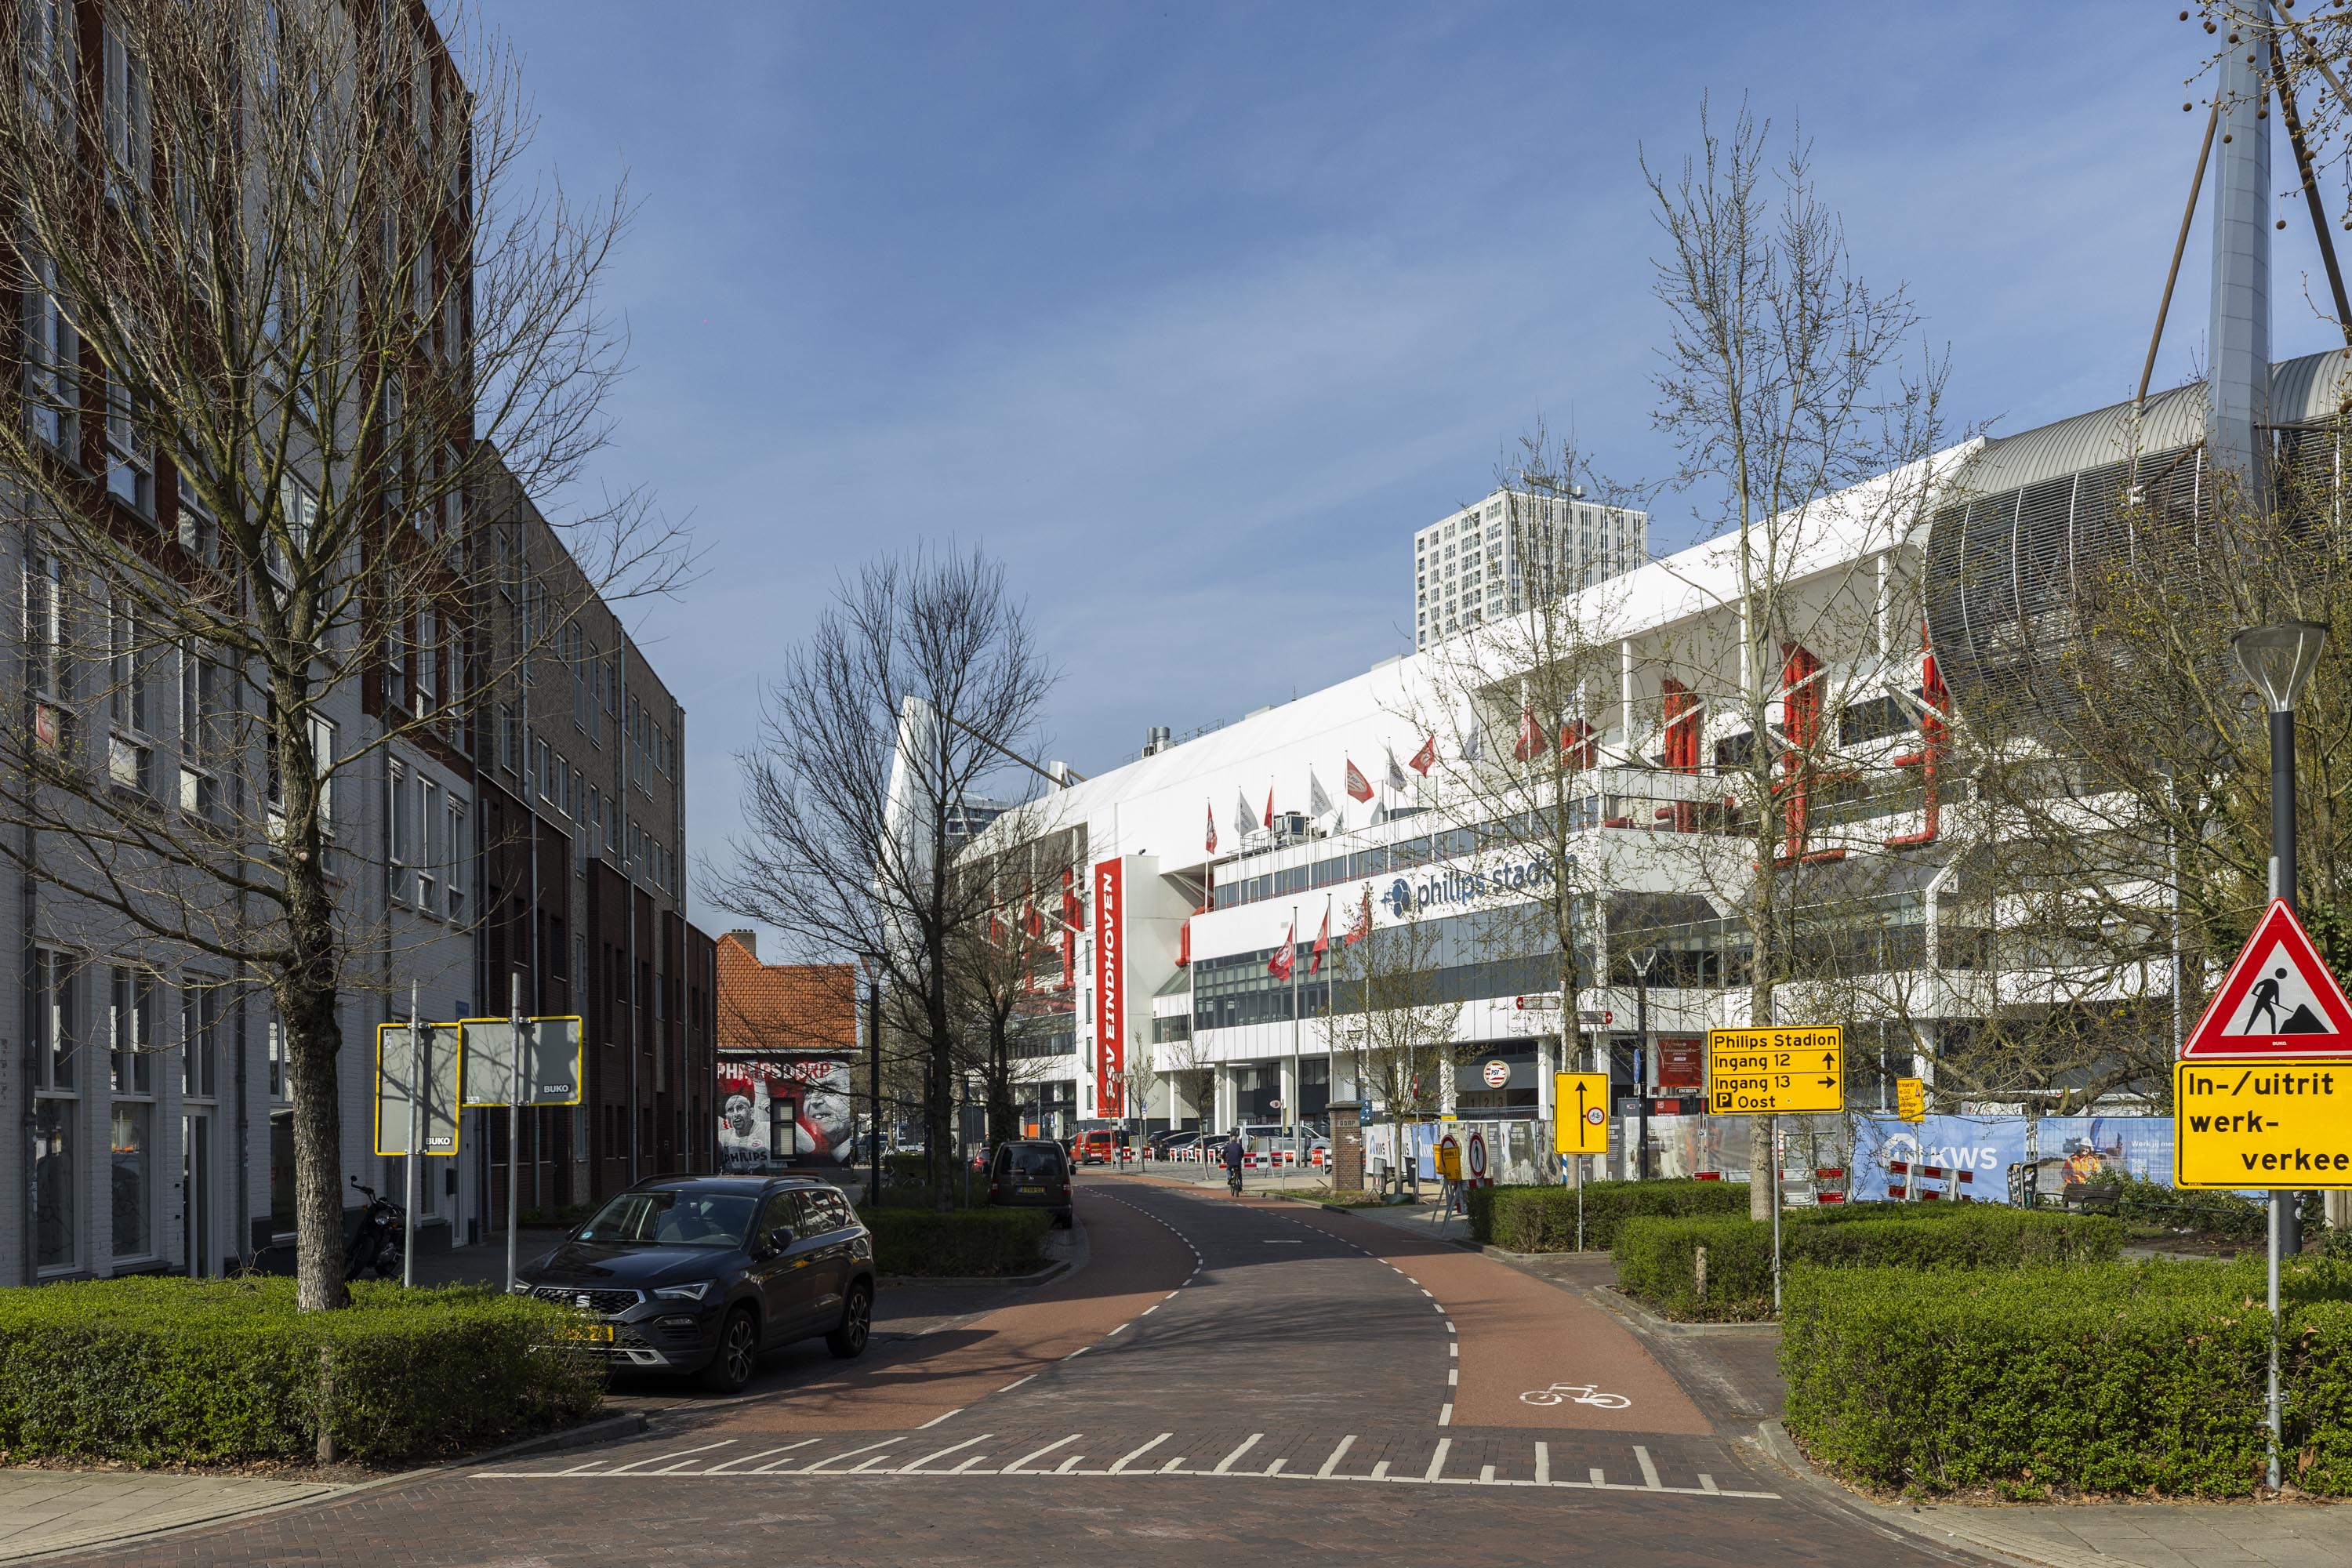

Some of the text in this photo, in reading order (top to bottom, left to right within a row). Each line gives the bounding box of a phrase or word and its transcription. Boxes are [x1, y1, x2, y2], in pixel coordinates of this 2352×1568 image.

[1417, 869, 1485, 912] philips
[1103, 873, 1115, 1040] EINDHOVEN
[1715, 1033, 1836, 1050] Philips Stadion
[1105, 1044, 1116, 1098] PSV
[1715, 1054, 1791, 1071] Ingang 12
[1715, 1076, 1791, 1093] Ingang 13
[2189, 1071, 2334, 1096] In-/uitrit
[1719, 1094, 1776, 1109] P Oost
[2189, 1110, 2279, 1133] werk-
[724, 1151, 768, 1163] PHILIPS
[1375, 1142, 1385, 1156] KWS
[1930, 1146, 1998, 1170] KWS
[2241, 1148, 2350, 1171] verkee
